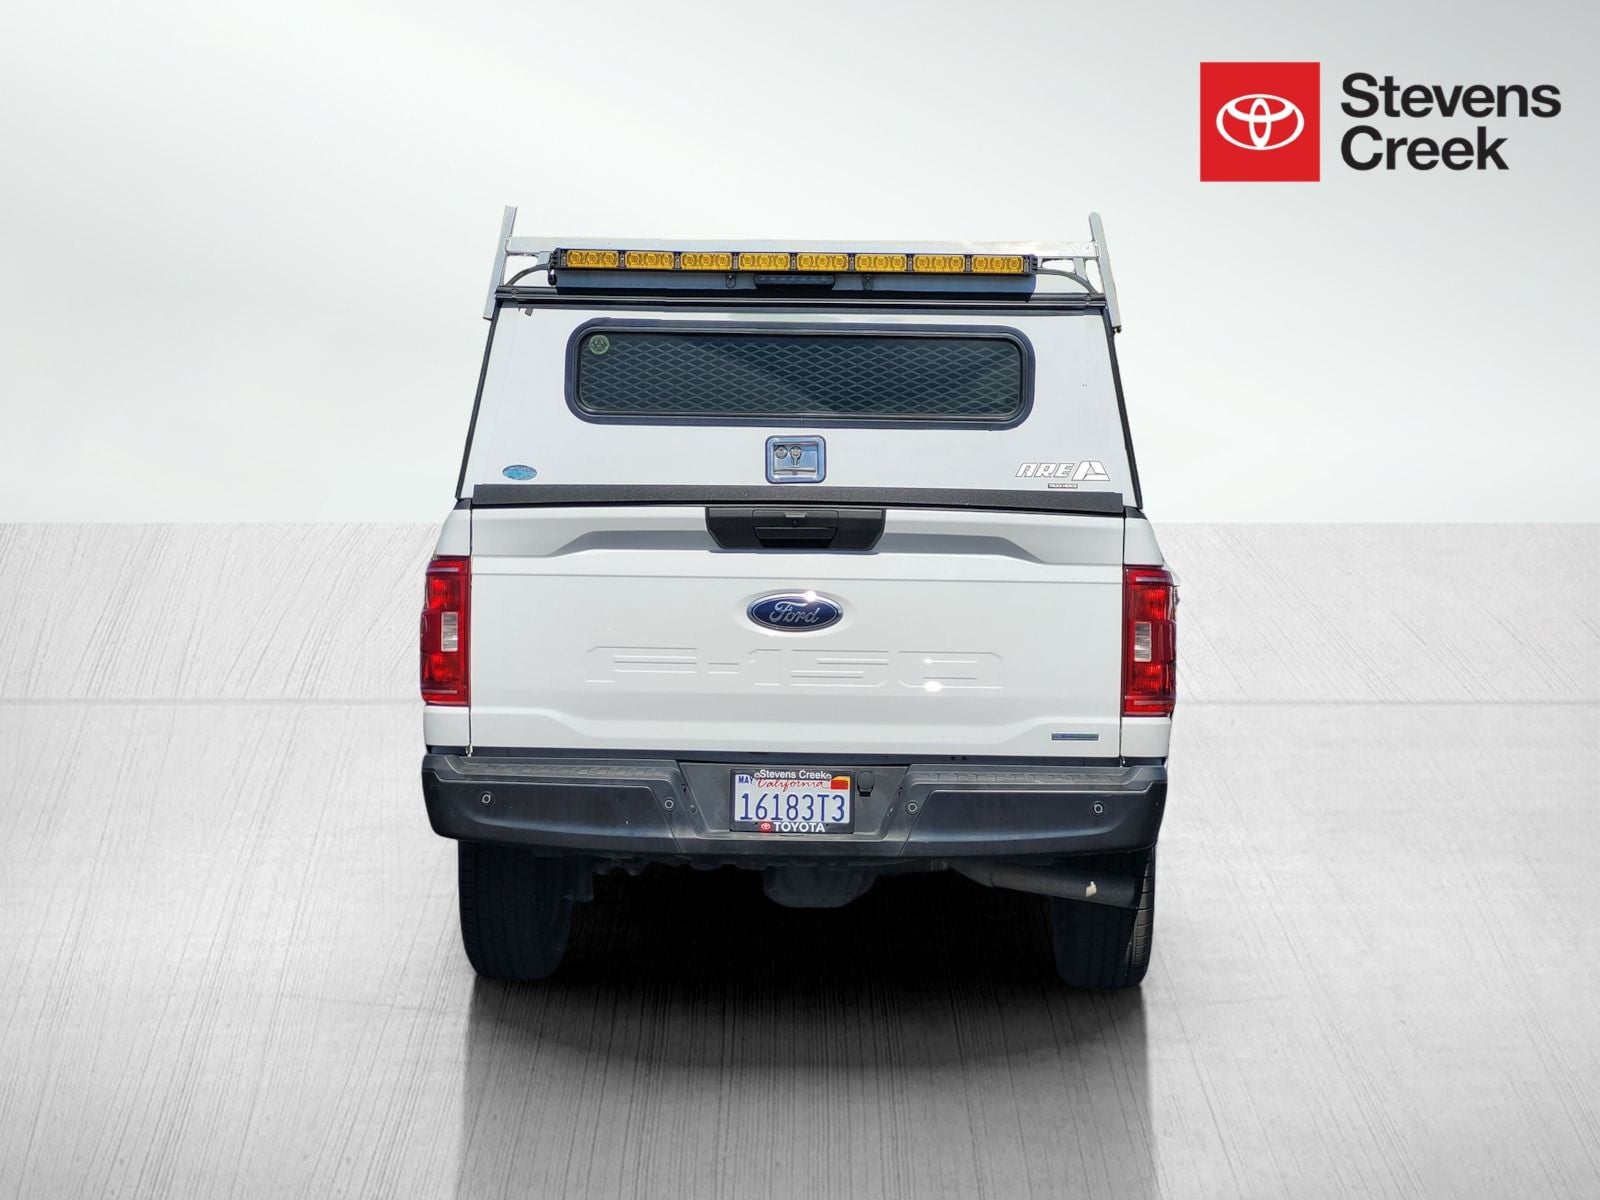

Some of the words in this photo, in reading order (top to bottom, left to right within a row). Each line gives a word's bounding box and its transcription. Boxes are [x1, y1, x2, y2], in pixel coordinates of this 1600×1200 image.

[1015, 462, 1075, 478] ARE
[768, 601, 821, 623] Ford
[586, 646, 1003, 690] F-150
[738, 775, 753, 784] MAY
[760, 769, 796, 779] Stevens
[798, 770, 826, 779] Creek
[758, 779, 824, 792] California
[740, 792, 845, 821] 16183T3
[774, 822, 826, 832] TOYOTA
